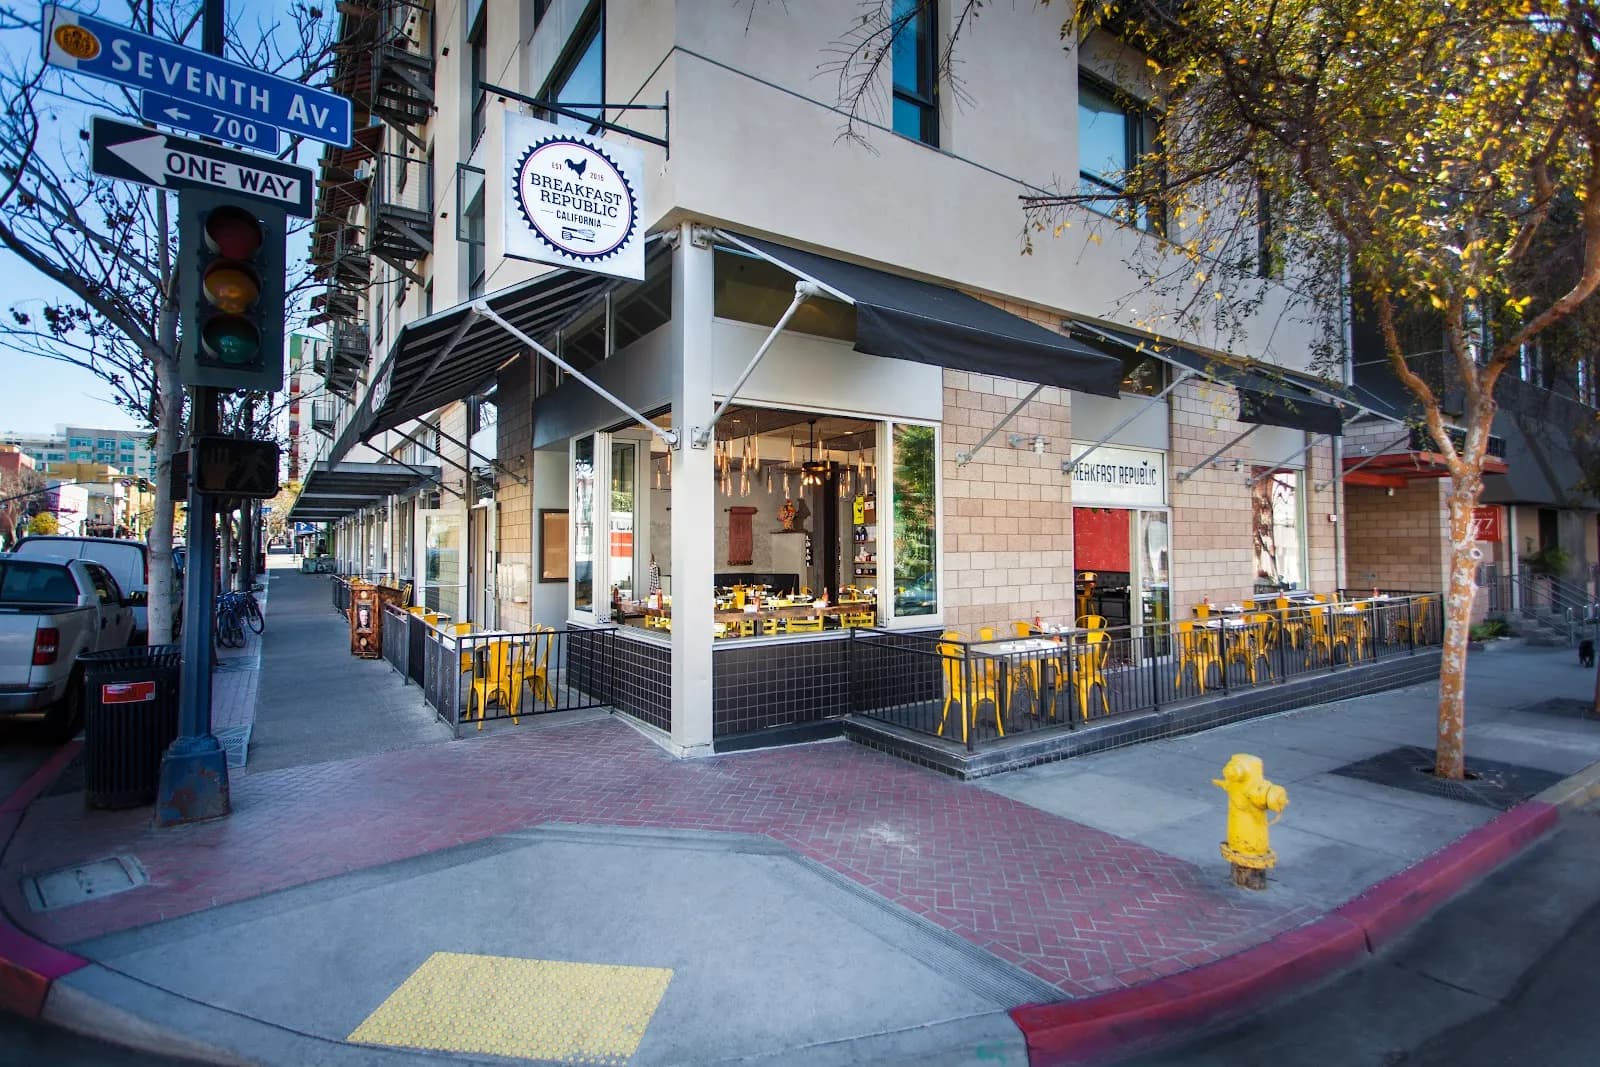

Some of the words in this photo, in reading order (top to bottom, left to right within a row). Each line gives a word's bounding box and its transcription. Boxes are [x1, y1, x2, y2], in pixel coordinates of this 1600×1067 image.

[110, 38, 270, 114] SEVENTH
[287, 94, 338, 134] AV.
[212, 114, 257, 143] 700
[166, 152, 227, 185] ONE
[238, 168, 294, 200] WAY
[551, 162, 563, 171] EST
[530, 172, 622, 206] BREAKFAST
[540, 189, 618, 218] REPUBLIC
[556, 209, 602, 229] CALIFORNIA
[1073, 462, 1117, 483] REAKFAST
[1119, 465, 1157, 486] REPUBLIC
